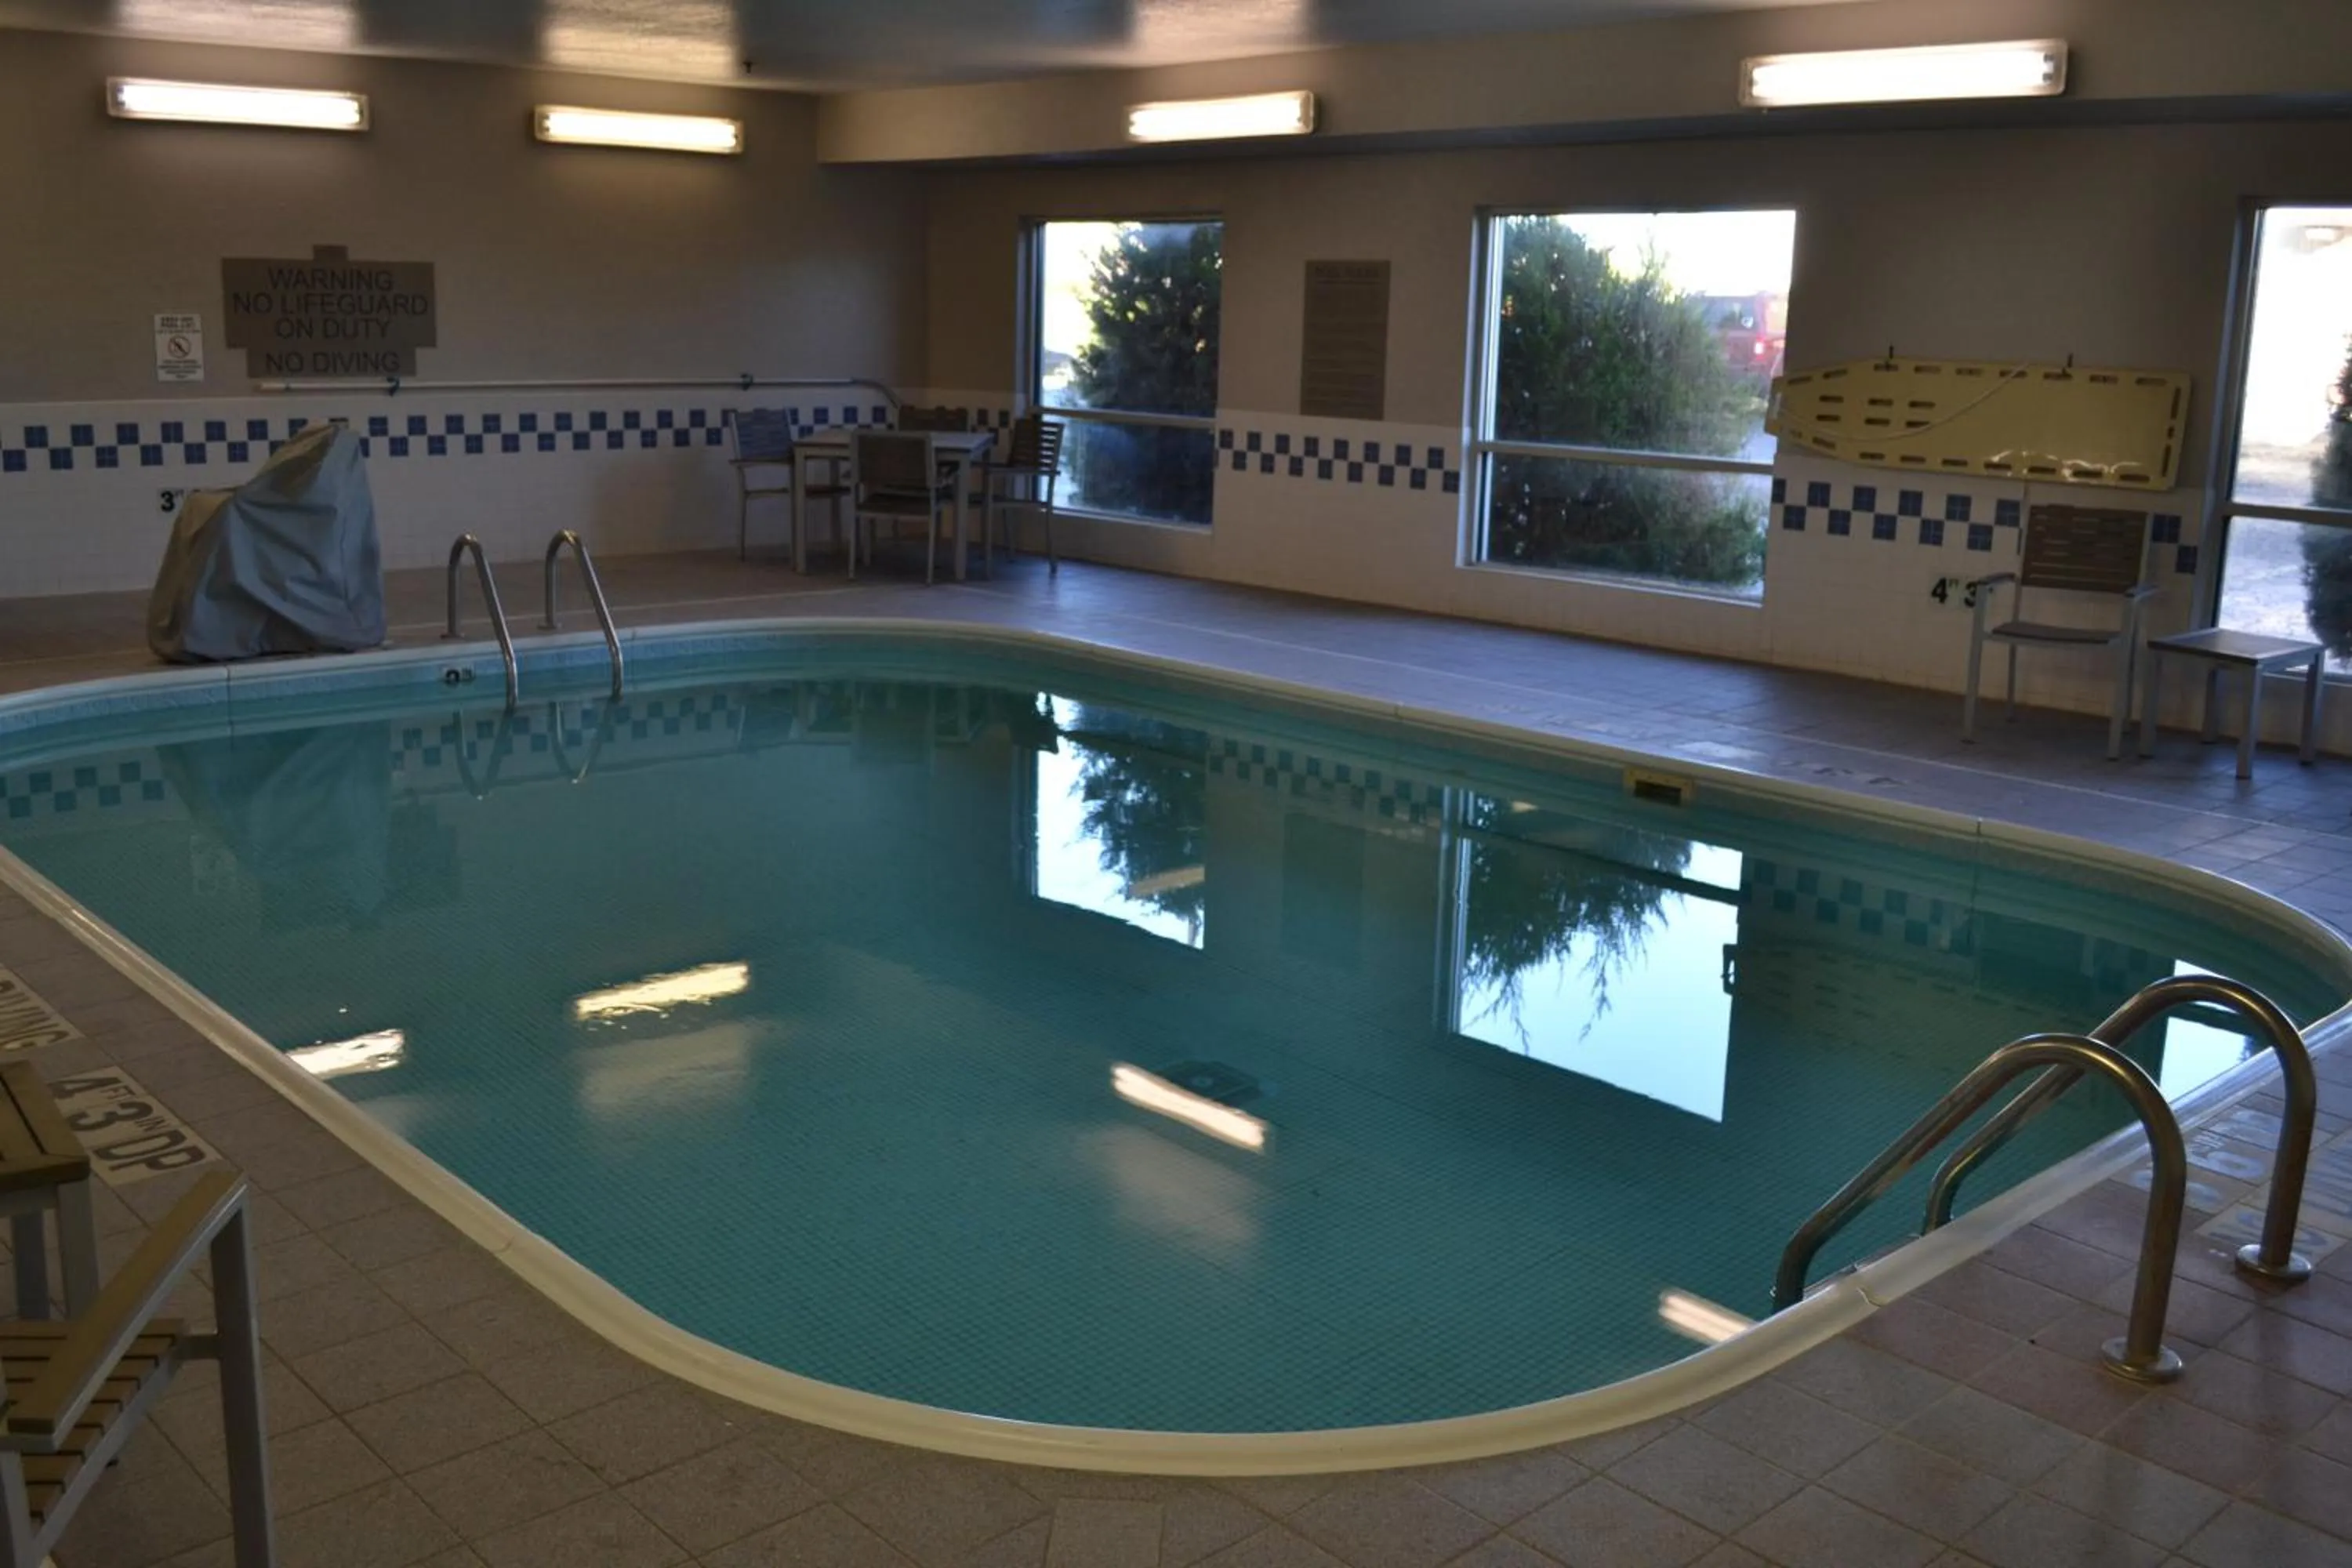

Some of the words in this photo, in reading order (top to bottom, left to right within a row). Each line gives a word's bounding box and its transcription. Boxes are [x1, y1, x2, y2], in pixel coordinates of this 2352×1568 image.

[268, 267, 394, 292] WARNING
[234, 291, 273, 314] NO
[281, 292, 428, 316] LIFEGUARD
[275, 318, 314, 339] ON
[323, 318, 391, 339] DUTY
[266, 351, 303, 373] NO
[313, 351, 400, 373] DIVING
